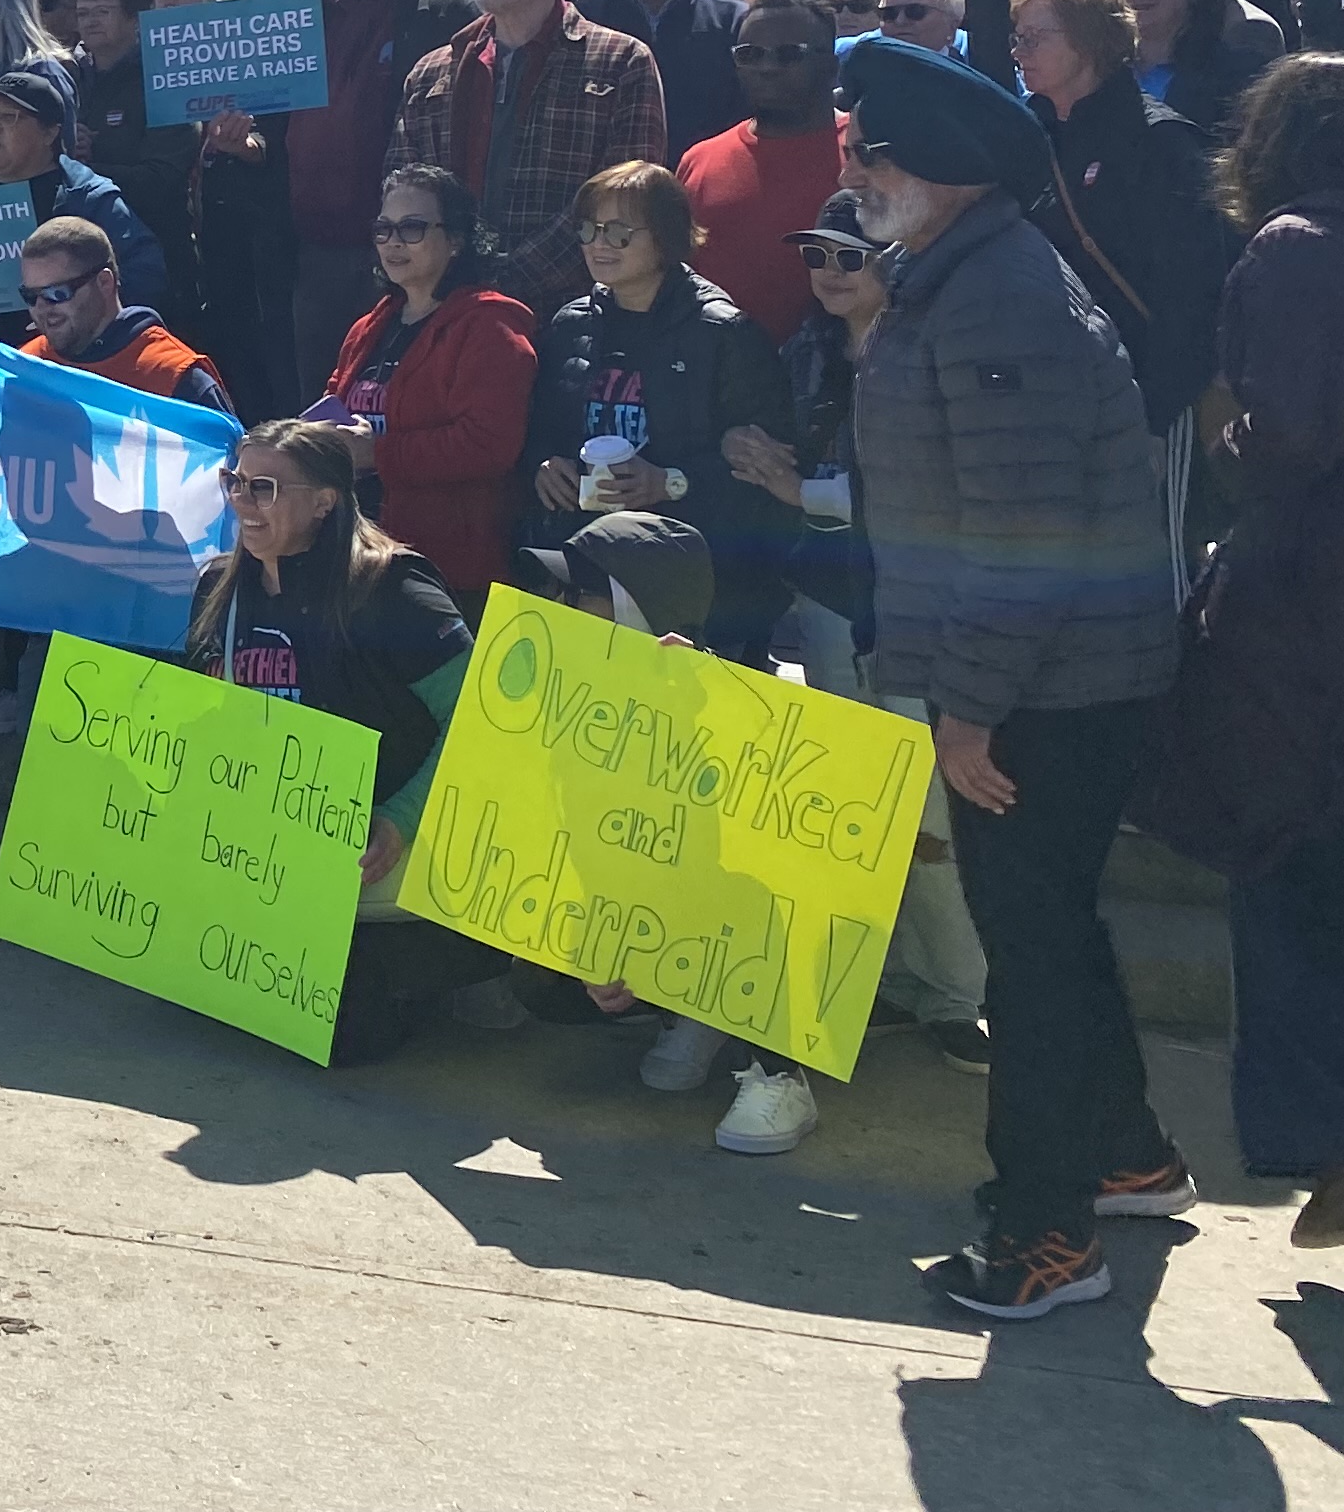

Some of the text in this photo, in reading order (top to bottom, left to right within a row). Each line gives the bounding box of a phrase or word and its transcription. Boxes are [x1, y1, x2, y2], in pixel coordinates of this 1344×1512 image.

[150, 8, 314, 47] HEALTH CARE
[164, 33, 303, 68] PROVIDERS
[152, 55, 318, 90] DESERVE A RAISE
[49, 660, 368, 850] Serving our Patients
[478, 610, 916, 872] Overworked
[102, 784, 286, 905] but barely
[598, 805, 686, 866] and
[9, 842, 161, 959] Surviving
